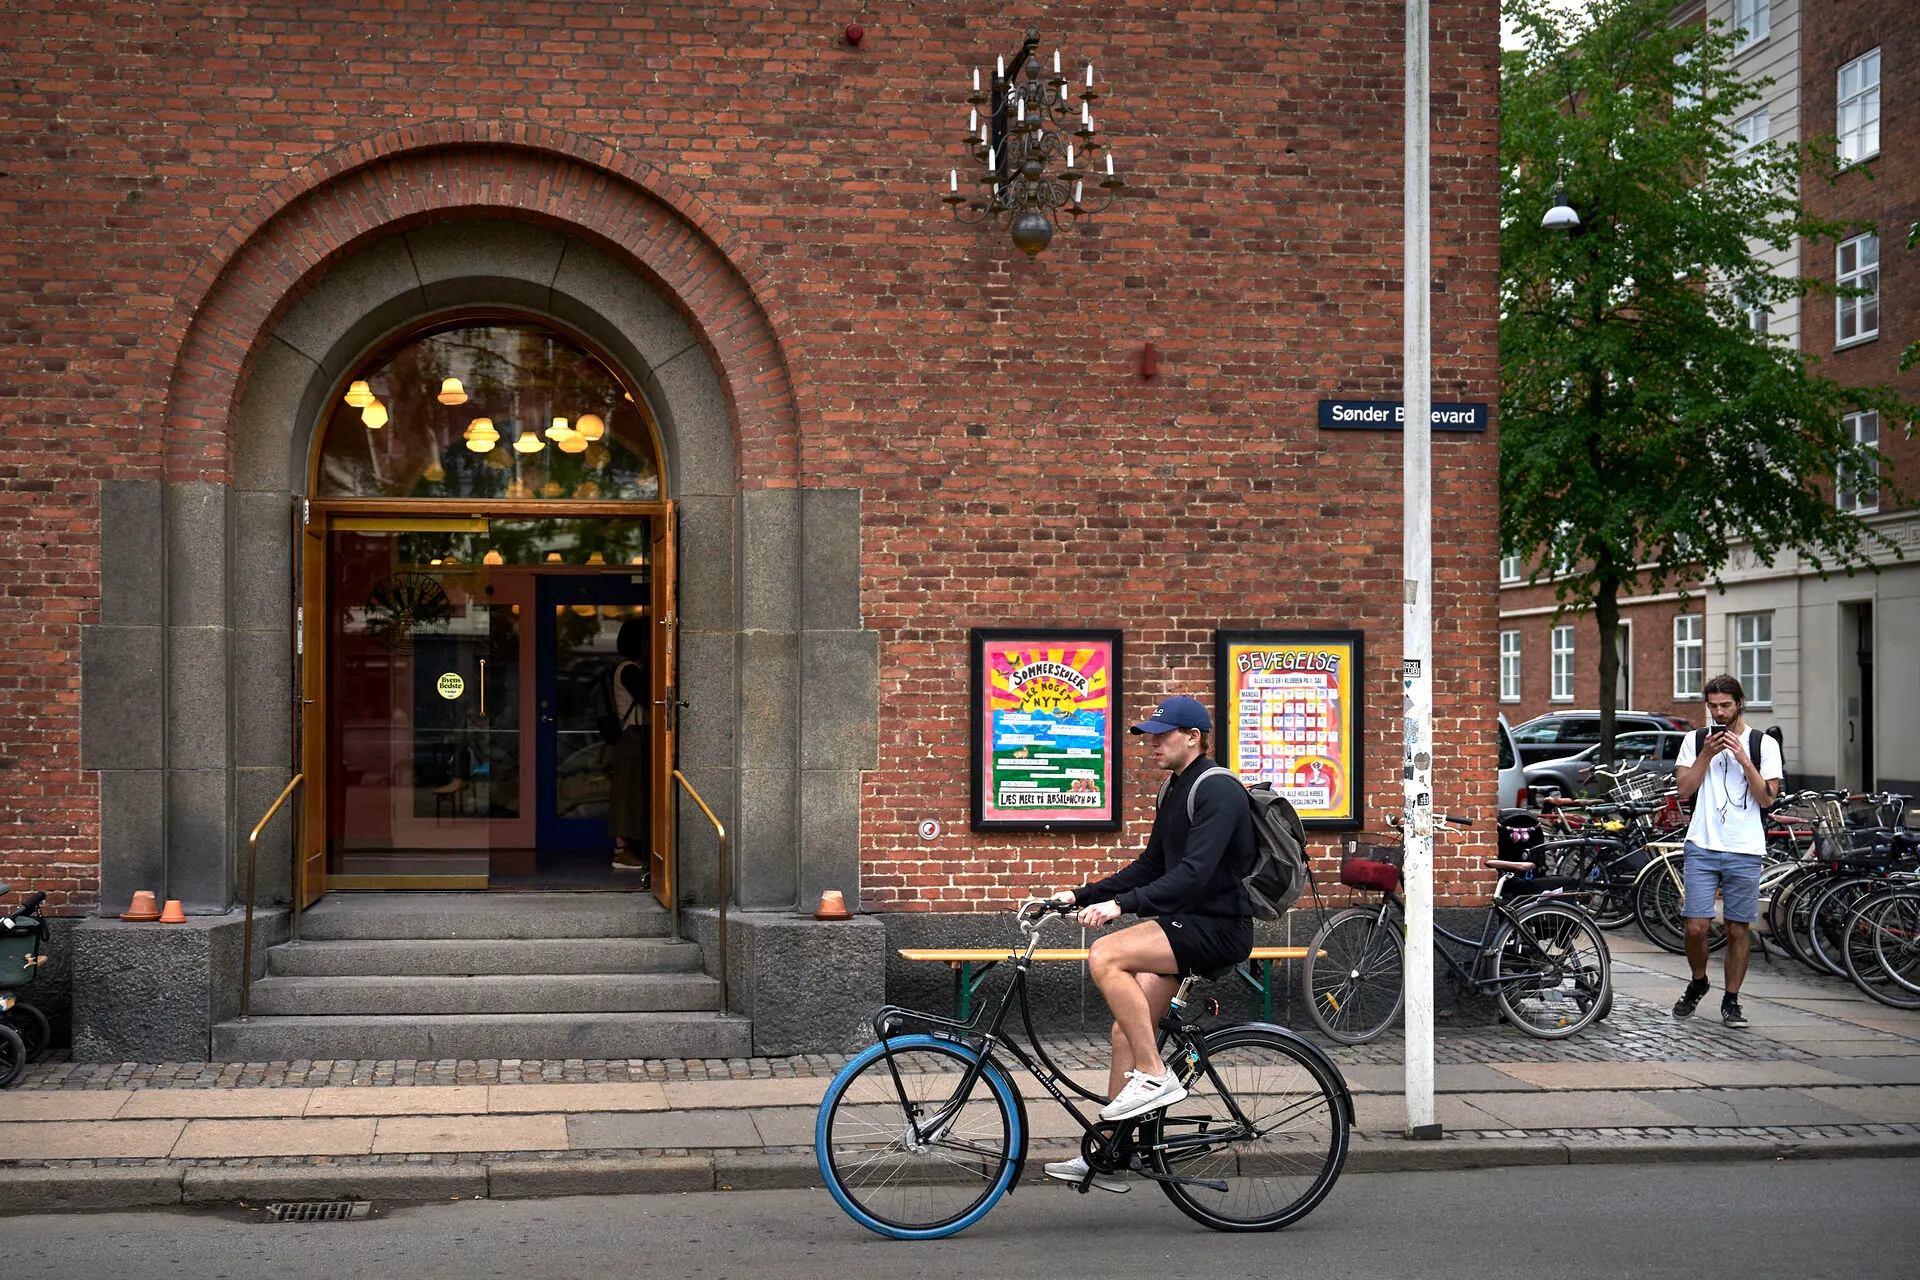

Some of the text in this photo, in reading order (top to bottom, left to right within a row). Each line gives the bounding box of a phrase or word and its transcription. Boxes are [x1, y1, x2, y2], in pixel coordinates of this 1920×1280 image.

[1332, 405, 1475, 424] Sønder Bevard
[1237, 650, 1341, 673] BEVÆGELSE
[1012, 663, 1087, 691] SOMMERSKOLER
[1041, 682, 1072, 701] NOGET
[1034, 696, 1061, 708] NYT
[1000, 793, 1017, 806] LÆS
[1018, 794, 1035, 805] MERE
